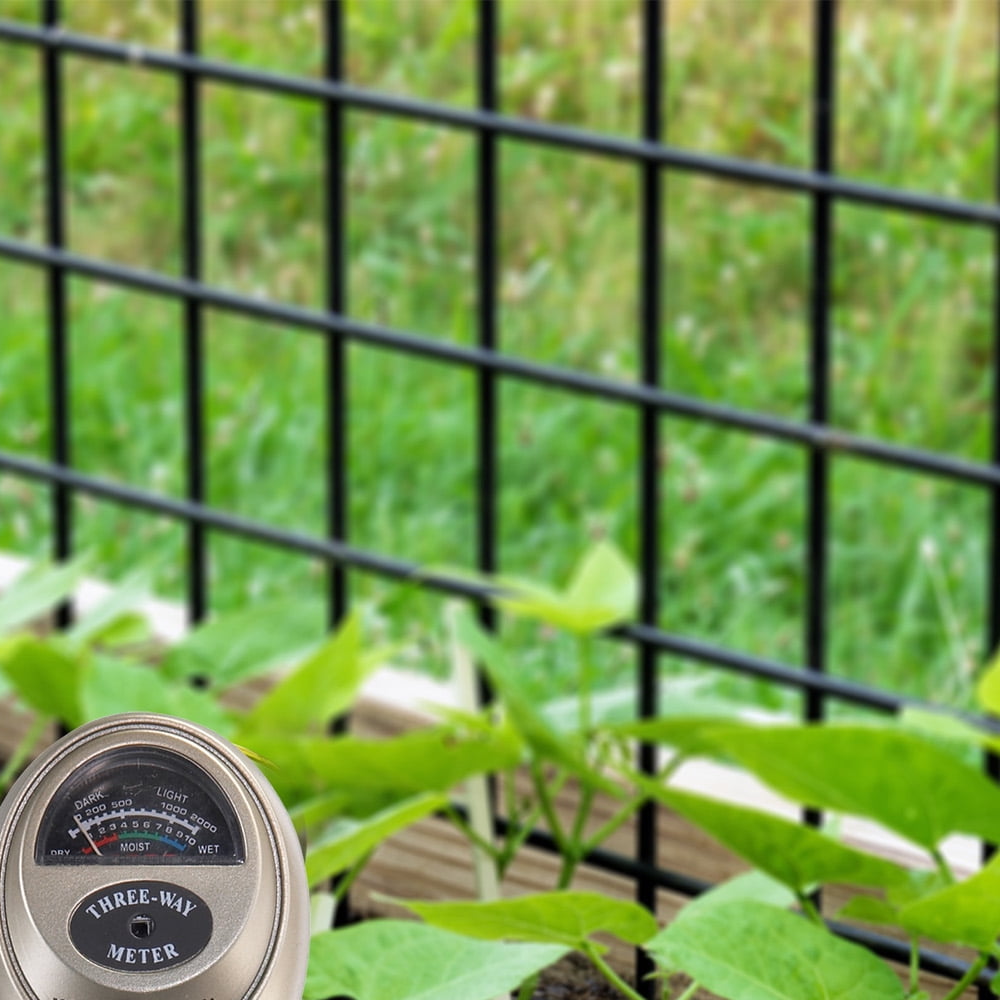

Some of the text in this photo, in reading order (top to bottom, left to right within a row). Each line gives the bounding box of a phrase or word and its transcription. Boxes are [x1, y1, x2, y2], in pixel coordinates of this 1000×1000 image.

[74, 791, 104, 810] DARK
[156, 787, 189, 803] LIGHT
[85, 804, 107, 816] 200
[111, 799, 132, 808] 500
[161, 801, 187, 815] 1000
[190, 813, 217, 833] 2000
[109, 823, 117, 831] 3
[185, 835, 197, 846] 10
[120, 842, 151, 852] MOIST
[198, 845, 220, 854] WET
[85, 888, 197, 919] THREE-WAY
[107, 943, 179, 964] METER
